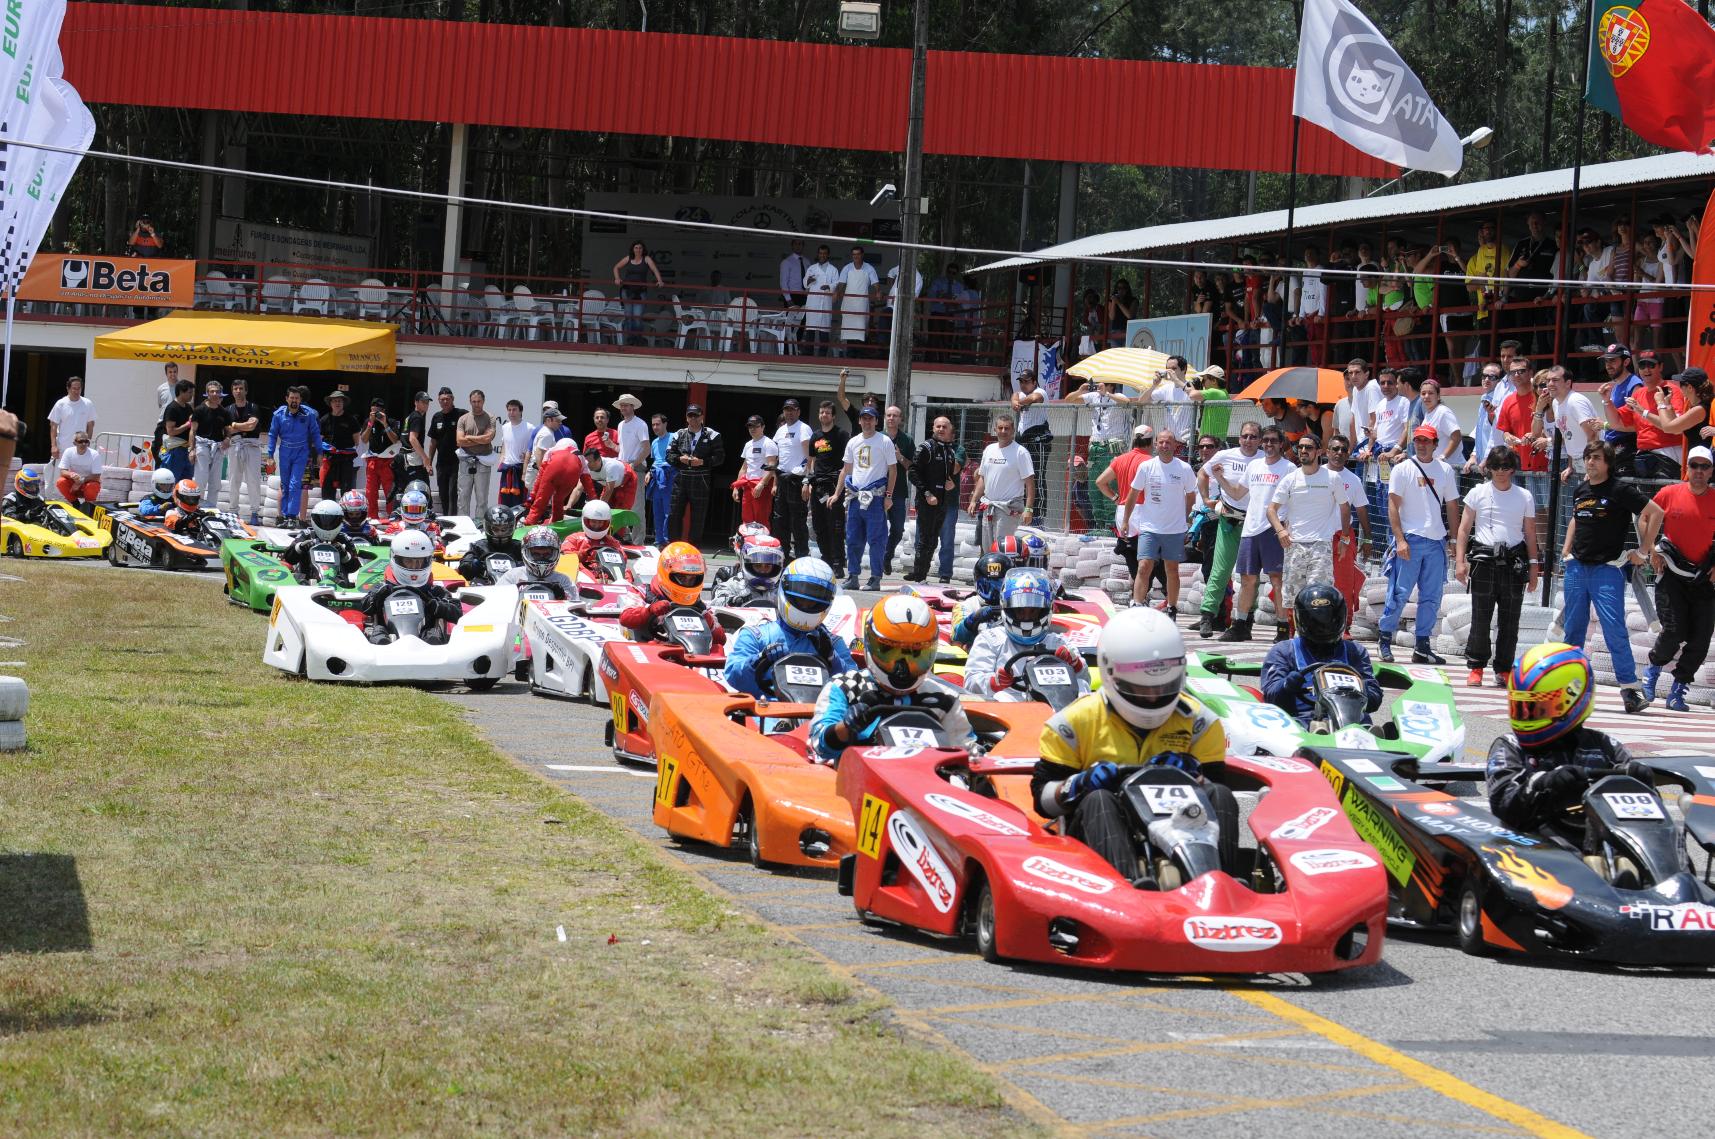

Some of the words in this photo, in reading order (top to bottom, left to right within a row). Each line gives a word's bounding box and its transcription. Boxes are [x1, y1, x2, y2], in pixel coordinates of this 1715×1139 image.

[92, 260, 171, 293] Beta
[134, 351, 300, 369] www.pestronix.pt
[1250, 473, 1280, 483] UNITRIP
[126, 529, 153, 558] Beta
[791, 666, 818, 676] 39
[1037, 667, 1066, 676] 103
[1329, 673, 1356, 684] 115
[898, 728, 922, 739] 17
[658, 758, 675, 801] 17
[1148, 786, 1189, 799] 74
[861, 799, 883, 852] 74
[1350, 788, 1409, 863] WARNING
[916, 844, 952, 907] liztrez
[1189, 920, 1277, 941] liztrez
